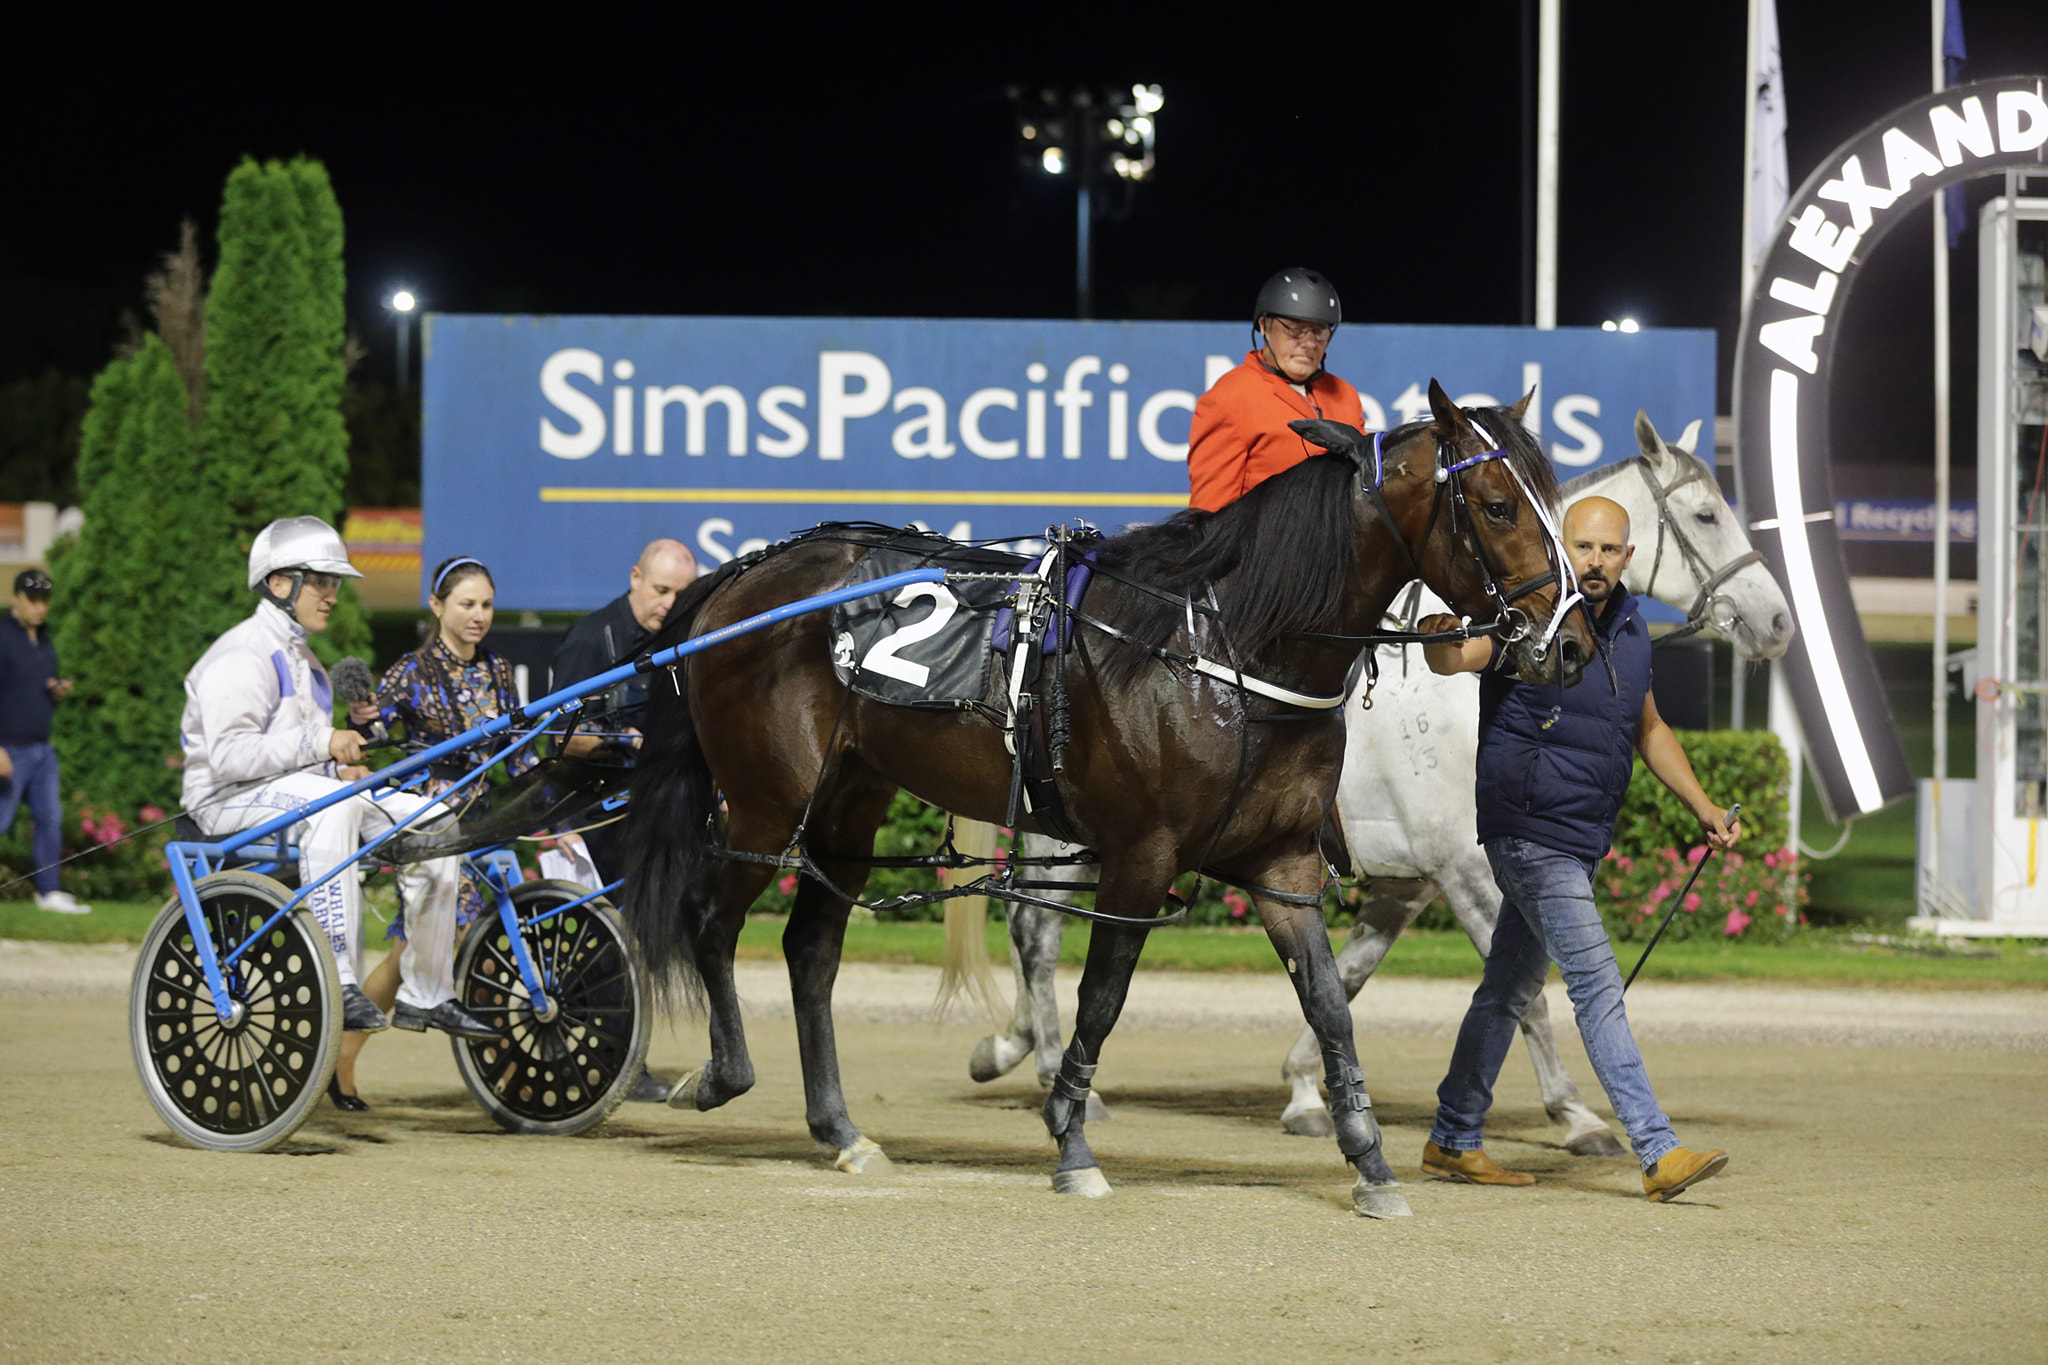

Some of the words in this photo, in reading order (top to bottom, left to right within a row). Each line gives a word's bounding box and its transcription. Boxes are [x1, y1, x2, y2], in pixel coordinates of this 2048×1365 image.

[1759, 91, 2048, 375] ALEXAND
[1852, 502, 1976, 537] Recyclng
[862, 581, 958, 688] 2
[329, 880, 347, 953] WHALES
